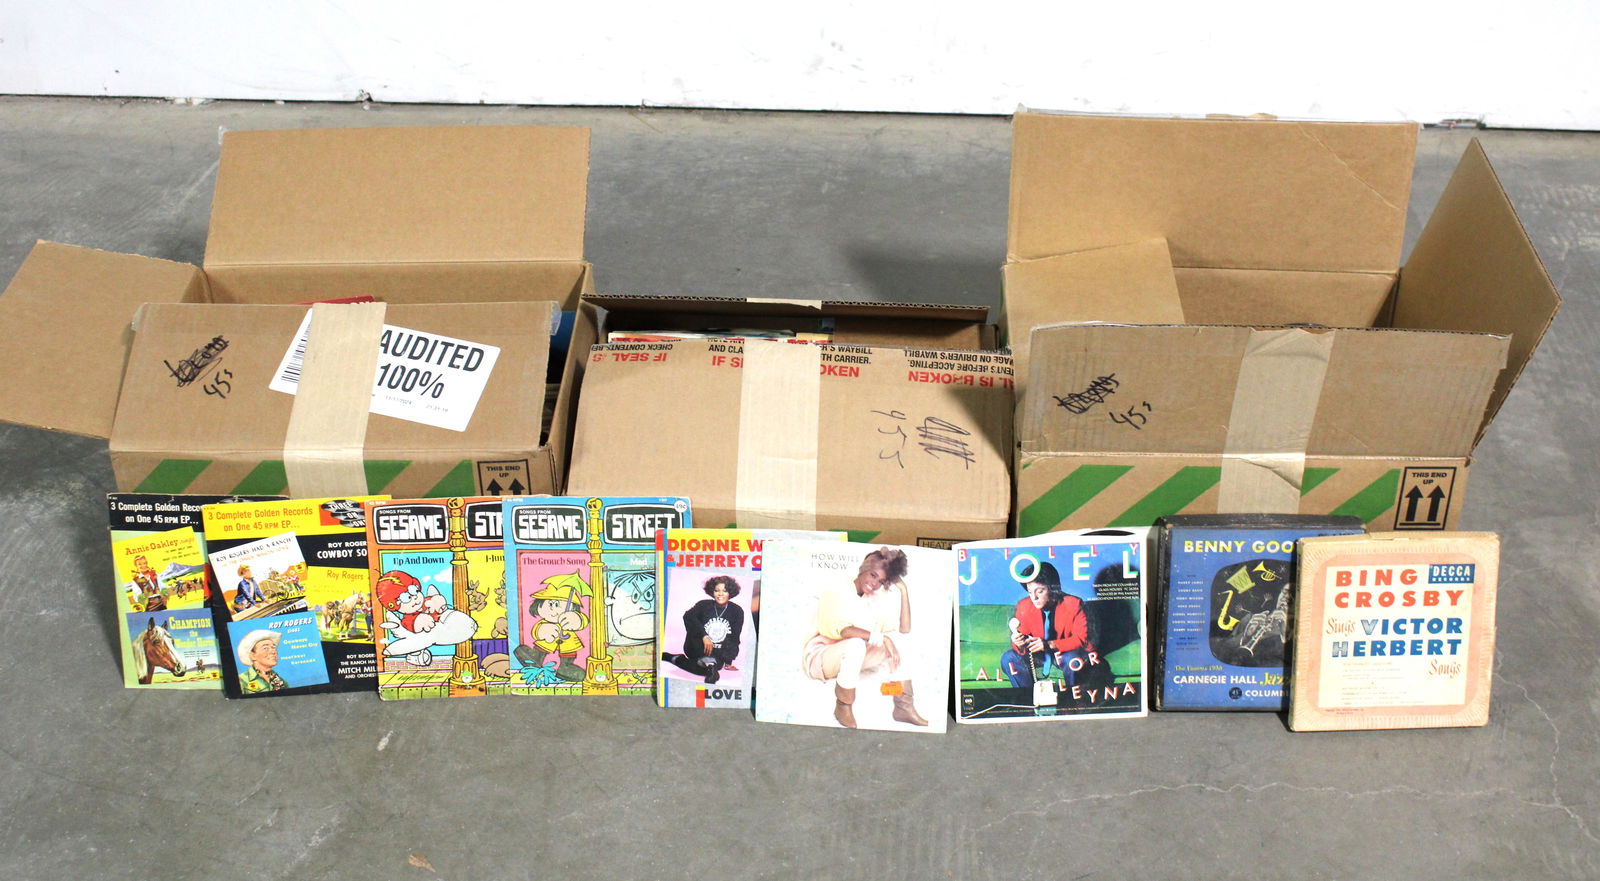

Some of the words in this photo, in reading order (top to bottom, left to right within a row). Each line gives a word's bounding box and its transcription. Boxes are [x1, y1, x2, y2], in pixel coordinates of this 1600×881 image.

[380, 330, 484, 372] AUDITED
[708, 344, 726, 352] AND
[820, 353, 832, 361] TH
[834, 354, 872, 364] CARRIER.
[838, 346, 873, 354] WAYBILL
[612, 352, 650, 362] SEAL
[654, 352, 667, 362] IF
[712, 356, 725, 366] IF
[940, 352, 978, 362] DRIVER'S
[908, 360, 955, 370] ACCEPTING.
[957, 364, 988, 372] BEFORE
[378, 363, 444, 399] 100%
[979, 376, 994, 386] IS
[110, 502, 116, 510] 3
[118, 502, 153, 512] Complete
[155, 502, 180, 512] Golden
[182, 503, 201, 512] Reco
[136, 514, 152, 524] One
[154, 514, 163, 523] 45
[164, 516, 178, 524] RPM
[208, 512, 214, 520] 3
[216, 510, 252, 522] Complete
[254, 509, 280, 518] Golden
[283, 507, 313, 516] Records
[224, 524, 233, 532] on
[236, 522, 250, 531] One
[253, 522, 262, 530] 45
[379, 514, 444, 540] SESAME
[518, 514, 582, 540] SESAME
[612, 513, 676, 539] STREET
[125, 544, 150, 556] Annie
[150, 539, 178, 550] Oakley
[666, 538, 740, 552] DIONNE
[746, 539, 763, 552] W
[1184, 540, 1246, 553] BENNY
[1252, 540, 1294, 554] GOO
[317, 549, 353, 560] COWBOY
[838, 554, 859, 562] WILL
[393, 557, 404, 566] Up
[405, 556, 420, 564] And
[422, 556, 444, 564] Down
[522, 556, 536, 565] The
[538, 556, 566, 566] Grouch
[566, 556, 586, 566] Song
[630, 558, 648, 566] Mad
[666, 554, 676, 563] &
[676, 554, 746, 568] JEFFREY
[818, 561, 848, 570] KNOW
[958, 550, 1139, 586] JOEL
[1432, 564, 1471, 576] DECCA
[326, 570, 340, 580] Roy
[342, 570, 364, 580] Rogers
[1336, 568, 1418, 586] BING
[1334, 590, 1464, 608] CROSBY
[268, 621, 282, 629] ROY
[284, 618, 313, 627] ROGERS
[1326, 617, 1356, 637] Sings
[1360, 618, 1463, 636] VICTOR
[1332, 638, 1462, 658] HERBERT
[1054, 652, 1100, 672] FOR
[338, 666, 362, 674] MITCH
[976, 662, 1018, 682] ALL
[1428, 658, 1462, 679] Songs
[1174, 675, 1226, 684] CARNEGIE
[1230, 675, 1257, 684] HALL
[704, 688, 742, 700] LOVE
[1058, 678, 1136, 703] LEYNA
